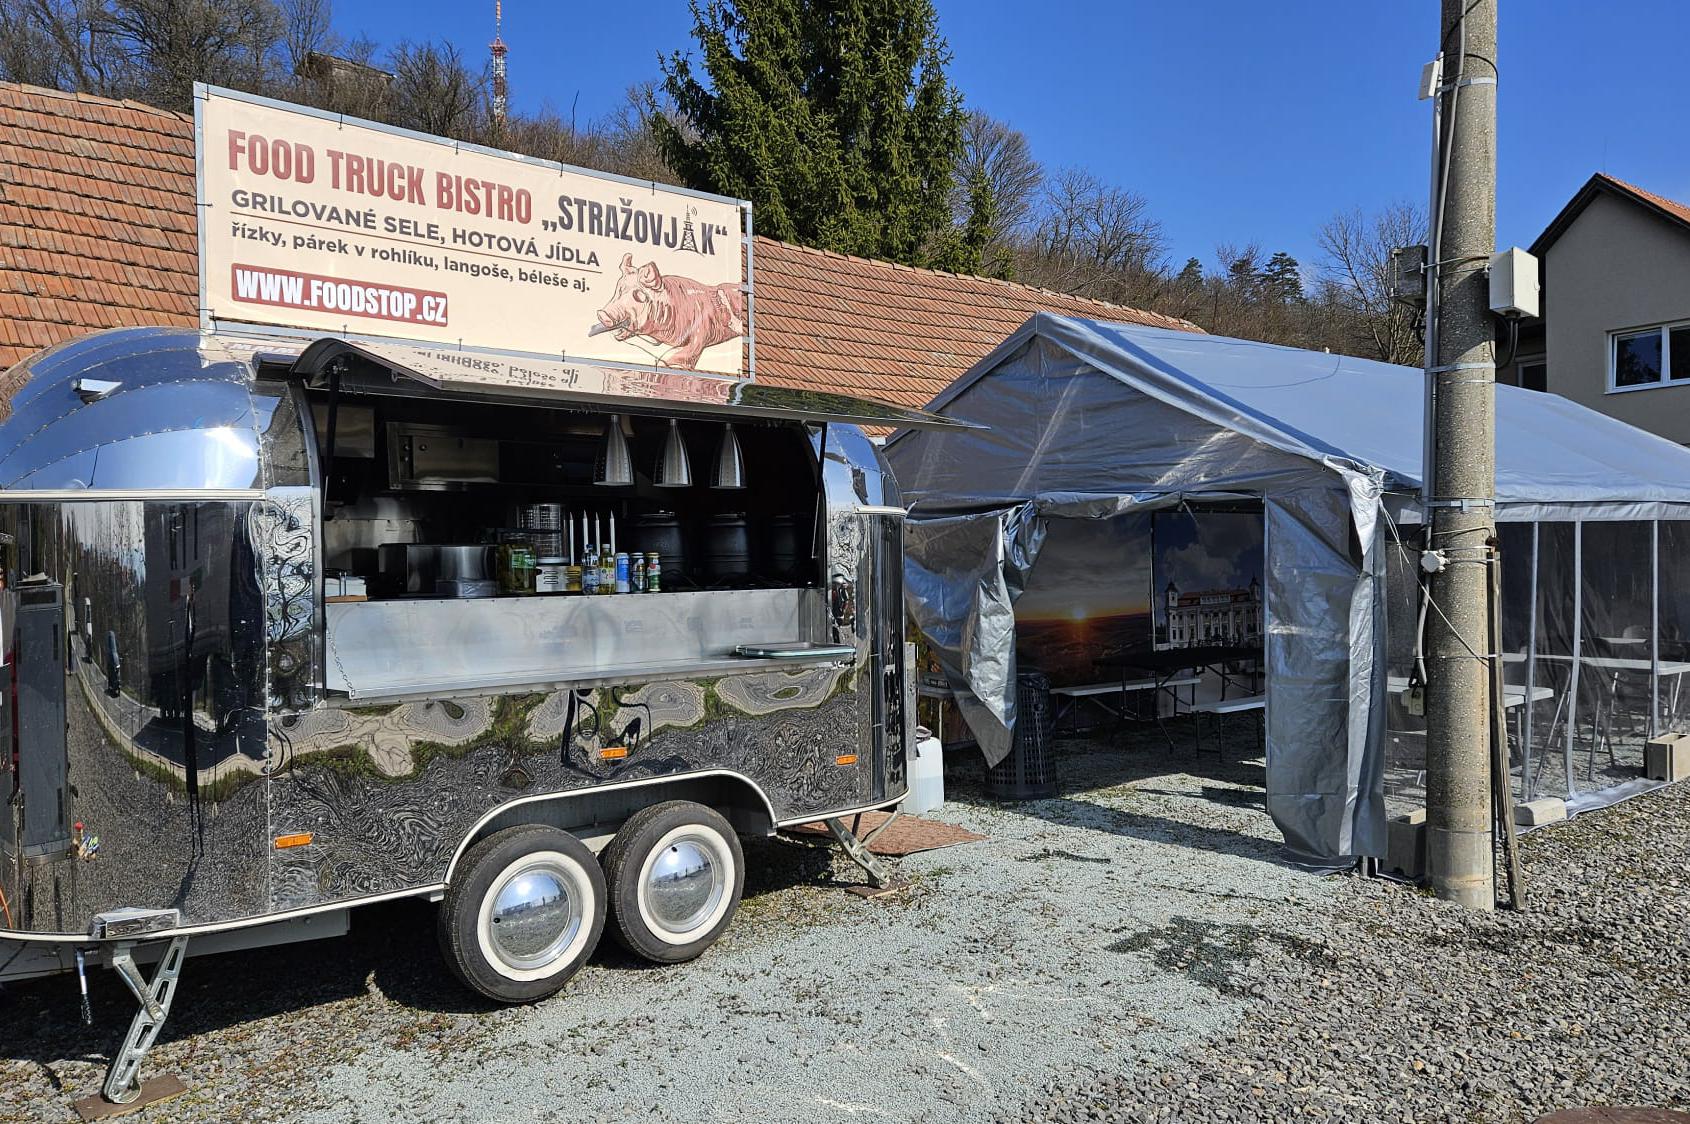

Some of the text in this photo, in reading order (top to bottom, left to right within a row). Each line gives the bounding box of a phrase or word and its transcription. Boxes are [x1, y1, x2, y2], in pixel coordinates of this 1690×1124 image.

[228, 129, 315, 184] FOOD
[326, 149, 426, 206] TRUCK
[436, 171, 532, 224] BISTRO
[231, 189, 600, 267] GRILOVANÉ SELE, HOTOVÁ JÍDLA
[231, 221, 590, 293] řízky, párek v rohlíku, langoše, béleše aj.
[236, 269, 447, 323] WWW.FOODSTOP.CZ
